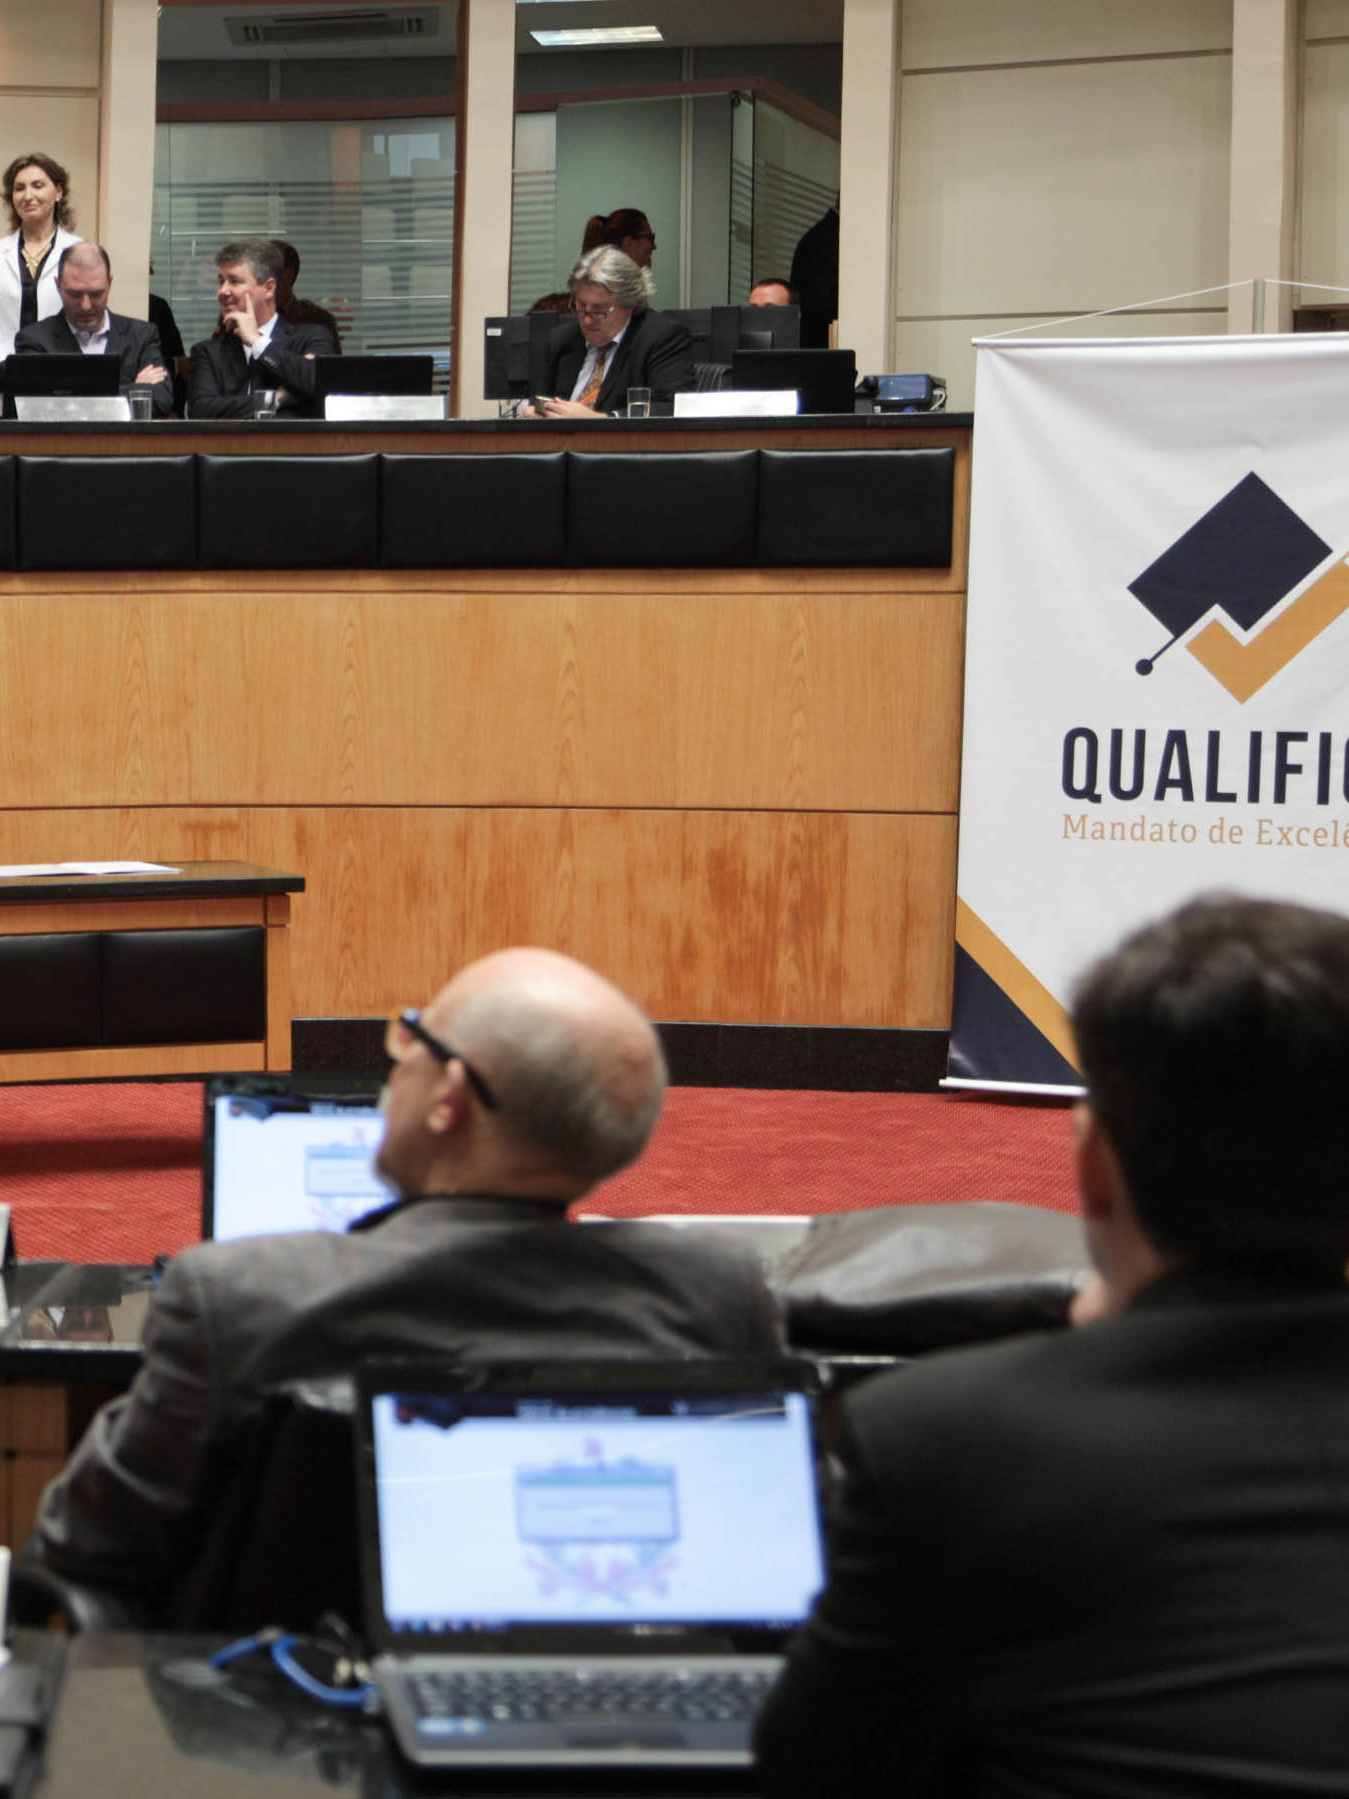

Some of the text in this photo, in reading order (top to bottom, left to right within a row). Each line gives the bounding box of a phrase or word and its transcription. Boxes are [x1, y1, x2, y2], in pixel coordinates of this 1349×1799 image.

[1062, 727, 1349, 806] QUALIFI
[1062, 814, 1198, 845] Mandato
[1208, 817, 1244, 846] de
